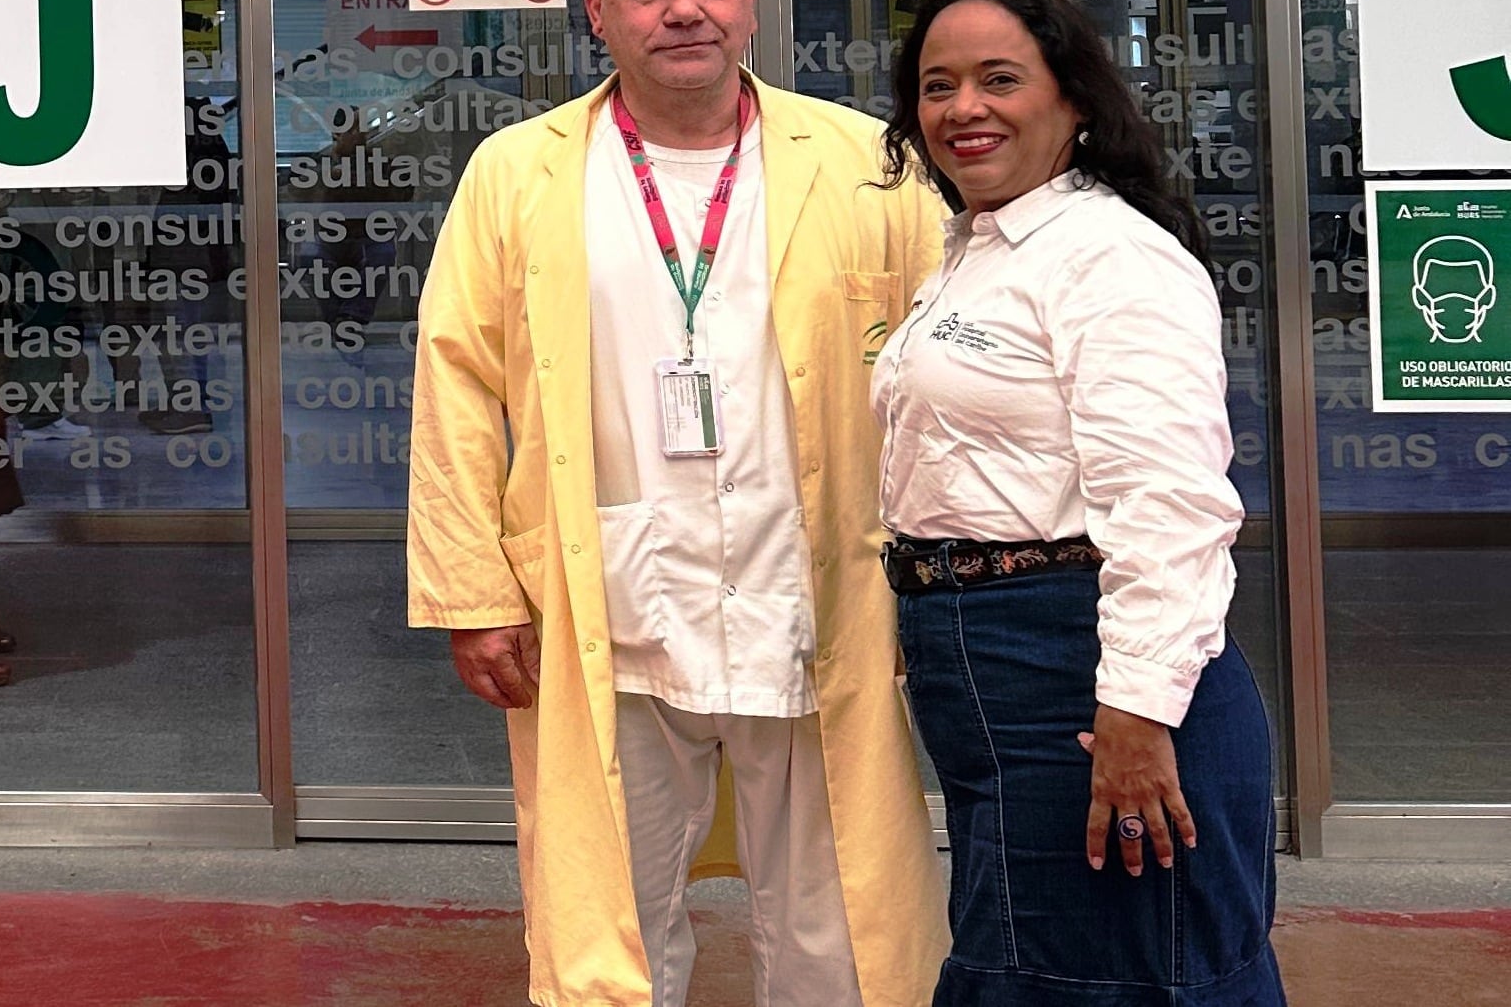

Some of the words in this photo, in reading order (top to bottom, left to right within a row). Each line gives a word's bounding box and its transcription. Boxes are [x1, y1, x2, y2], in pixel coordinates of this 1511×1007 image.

[281, 258, 426, 299] xtern
[929, 329, 953, 341] HUC
[1400, 360, 1425, 373] USO
[1429, 359, 1511, 373] OBLIGATORIO
[1402, 376, 1420, 388] DE
[1421, 375, 1511, 388] MASCARILLAS
